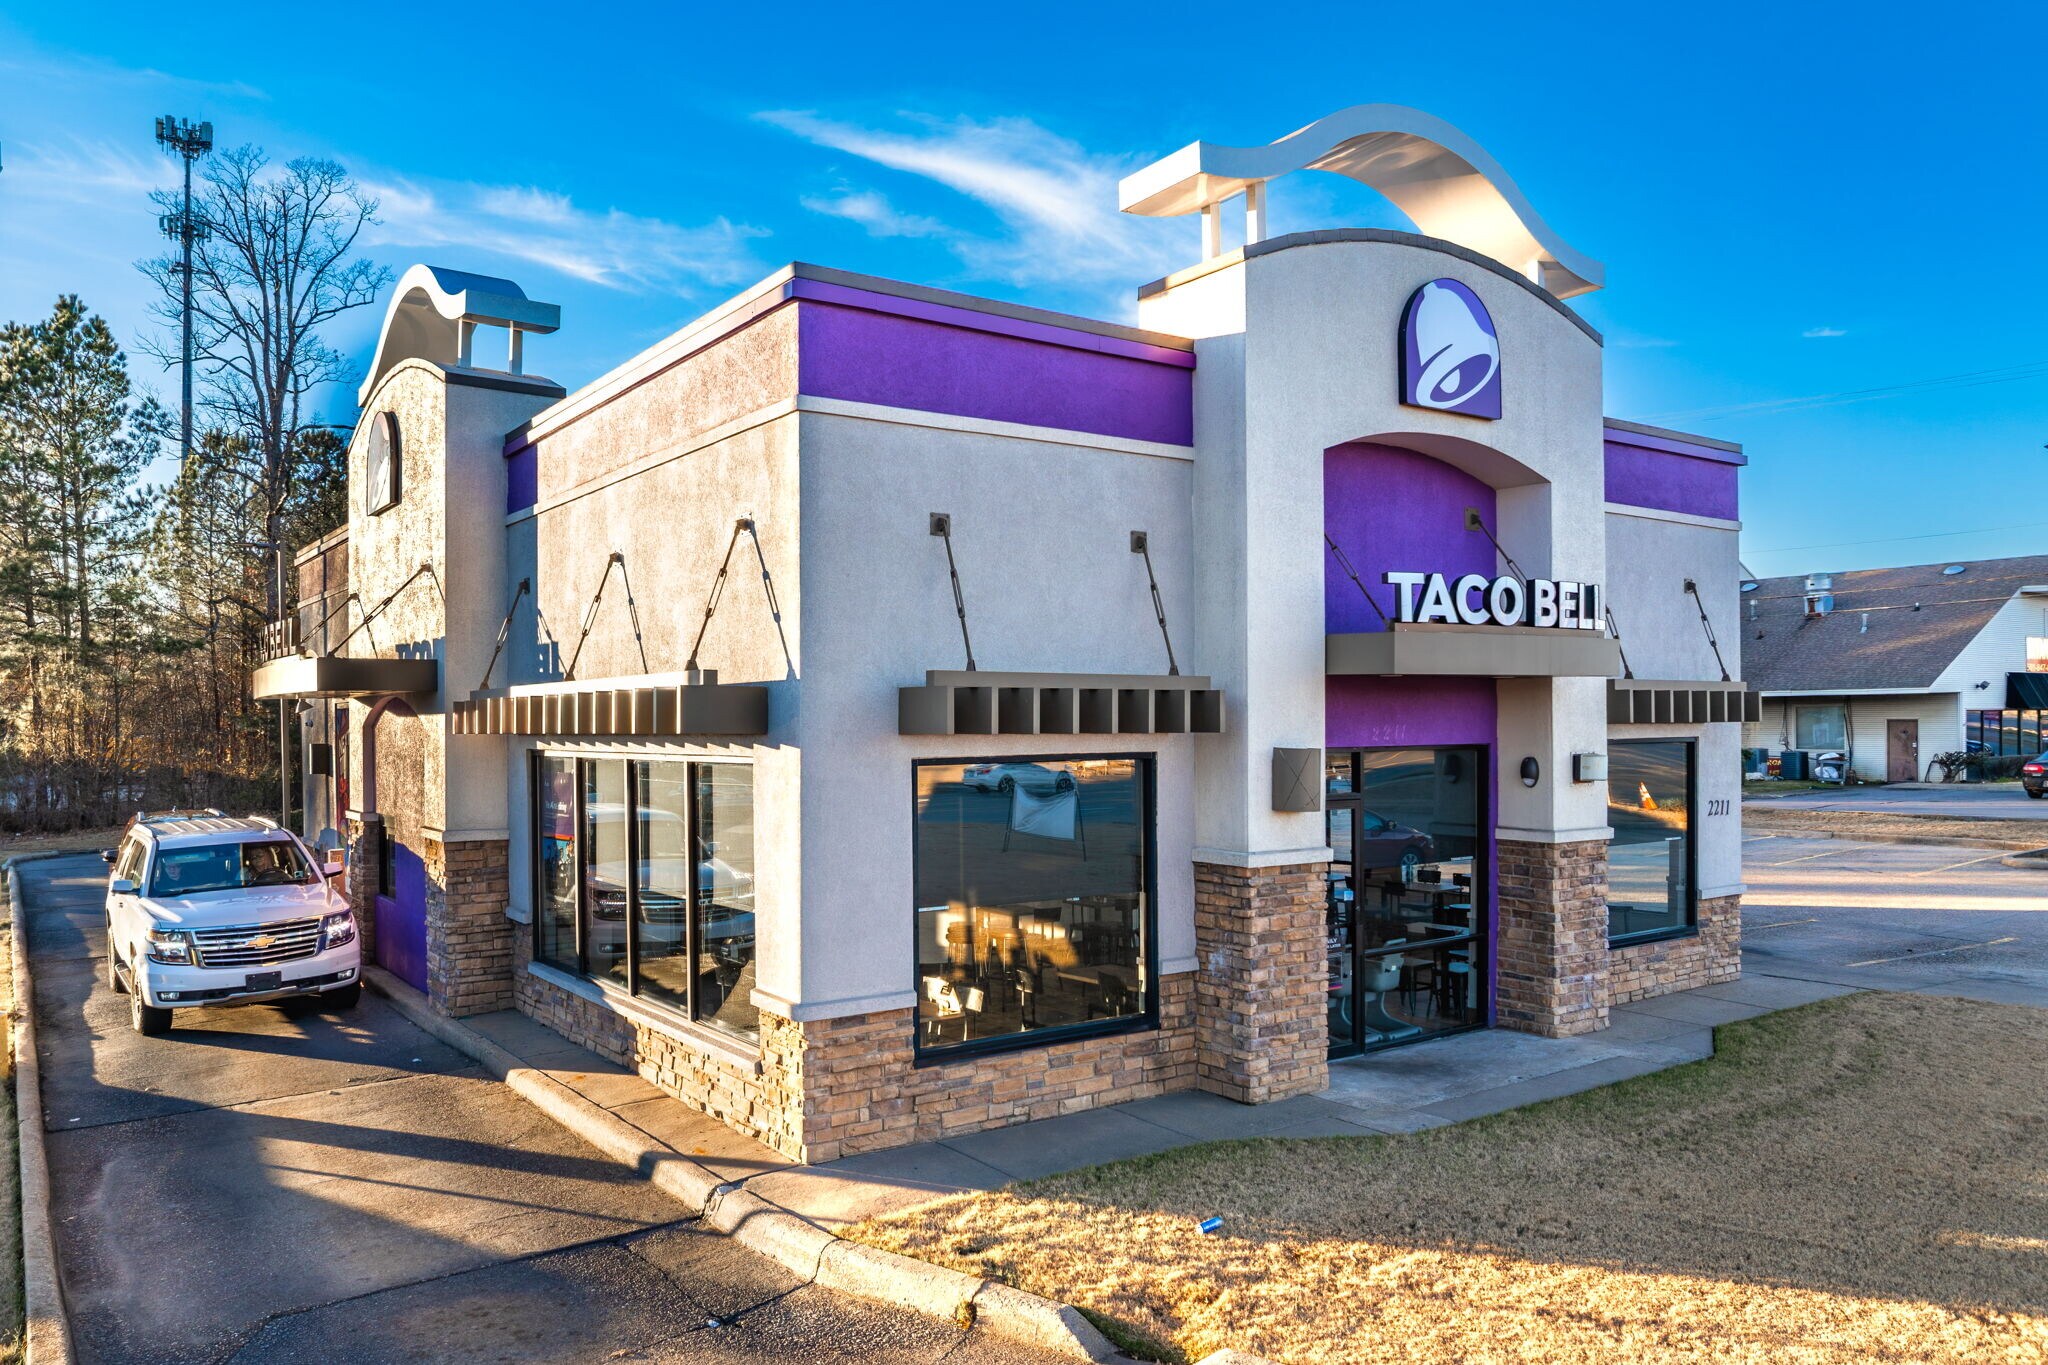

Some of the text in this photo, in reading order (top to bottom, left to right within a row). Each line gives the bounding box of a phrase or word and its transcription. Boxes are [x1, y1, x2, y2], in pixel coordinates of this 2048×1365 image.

[1384, 571, 1606, 631] TACO BELL
[269, 616, 297, 660] BELL
[1707, 799, 1730, 817] 2211
